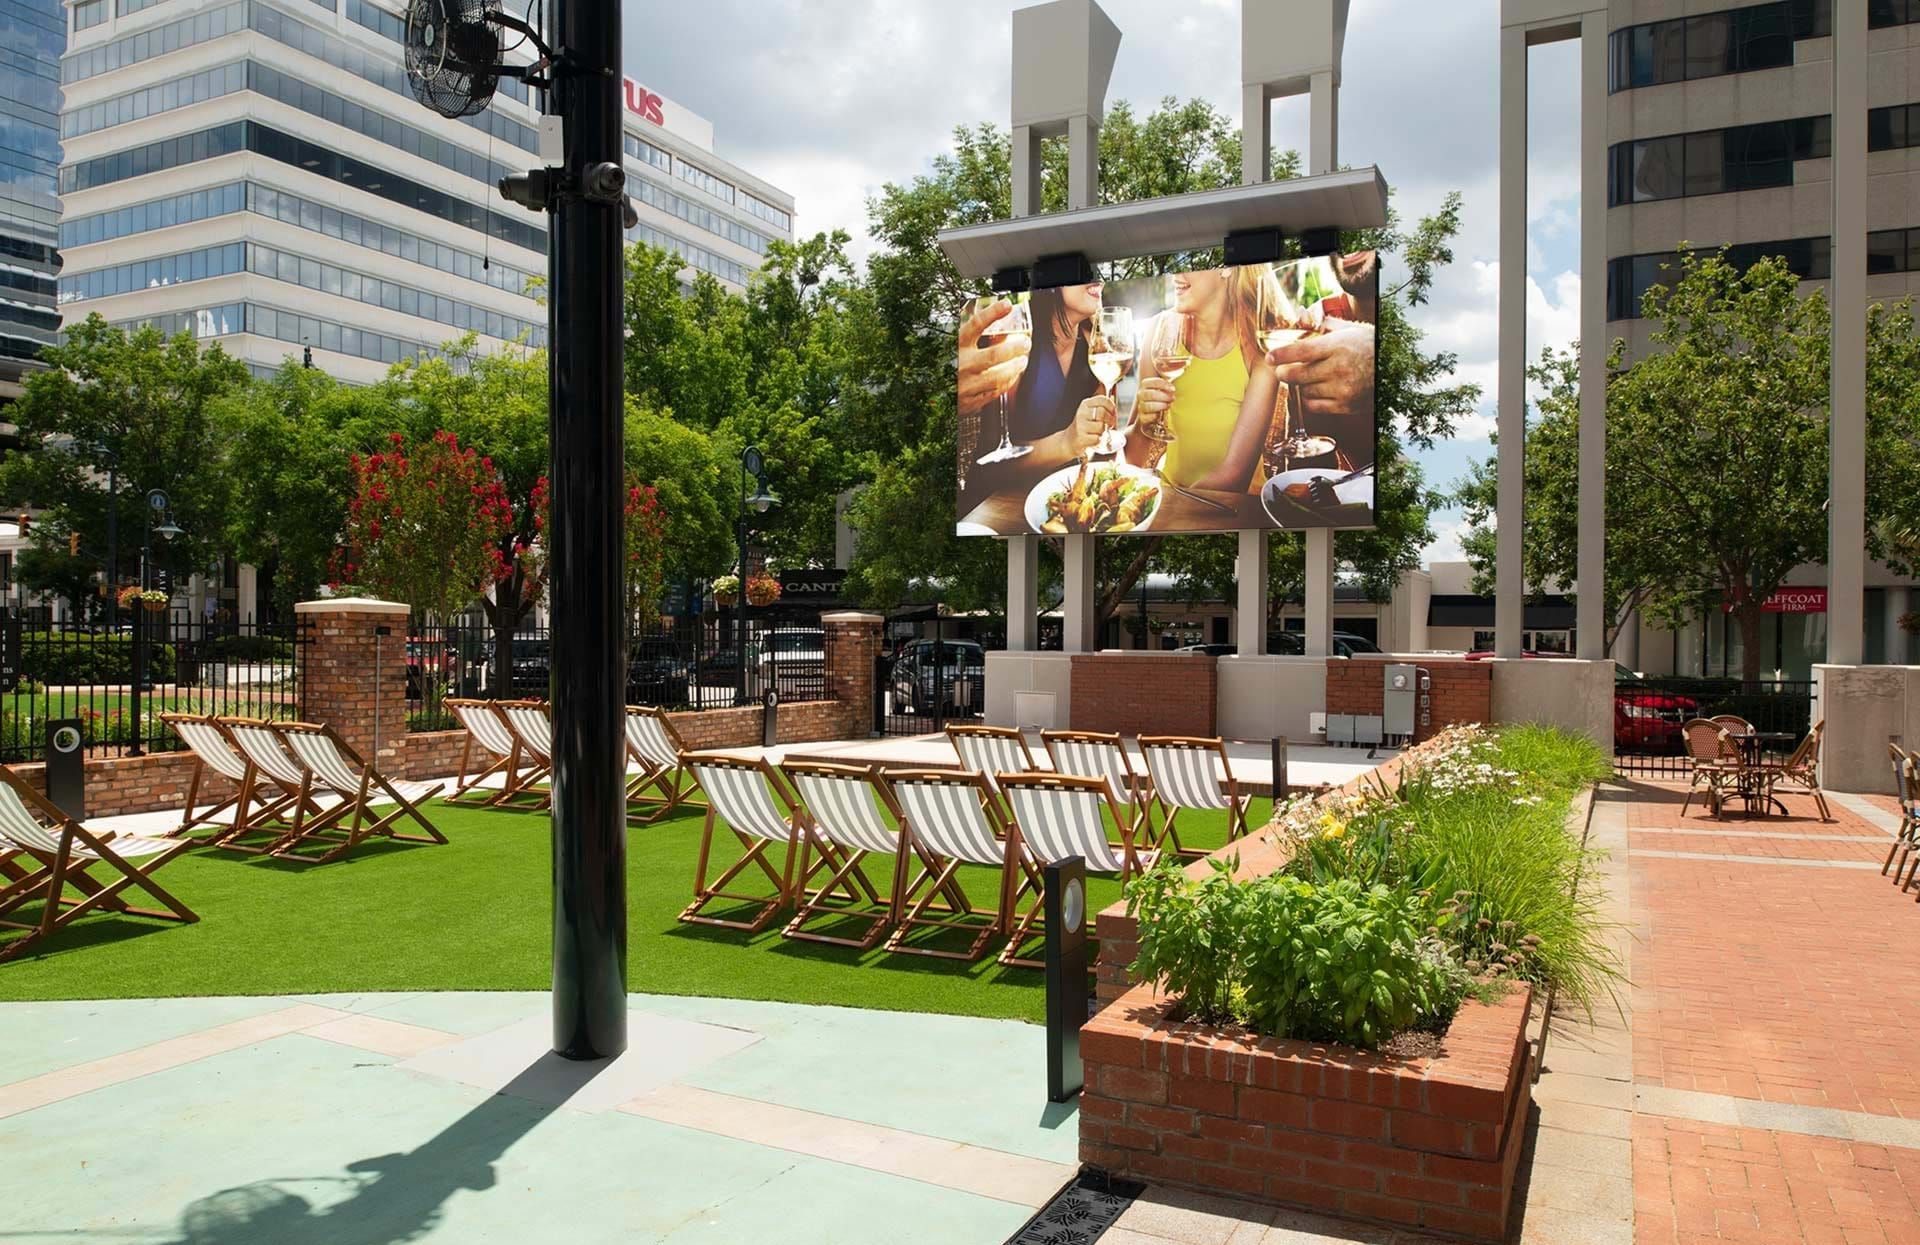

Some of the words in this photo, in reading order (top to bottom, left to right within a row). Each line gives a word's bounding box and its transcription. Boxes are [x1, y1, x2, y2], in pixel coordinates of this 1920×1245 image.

[624, 78, 664, 126] US
[785, 582, 841, 592] CANT
[1765, 594, 1824, 604] EFFCOAT
